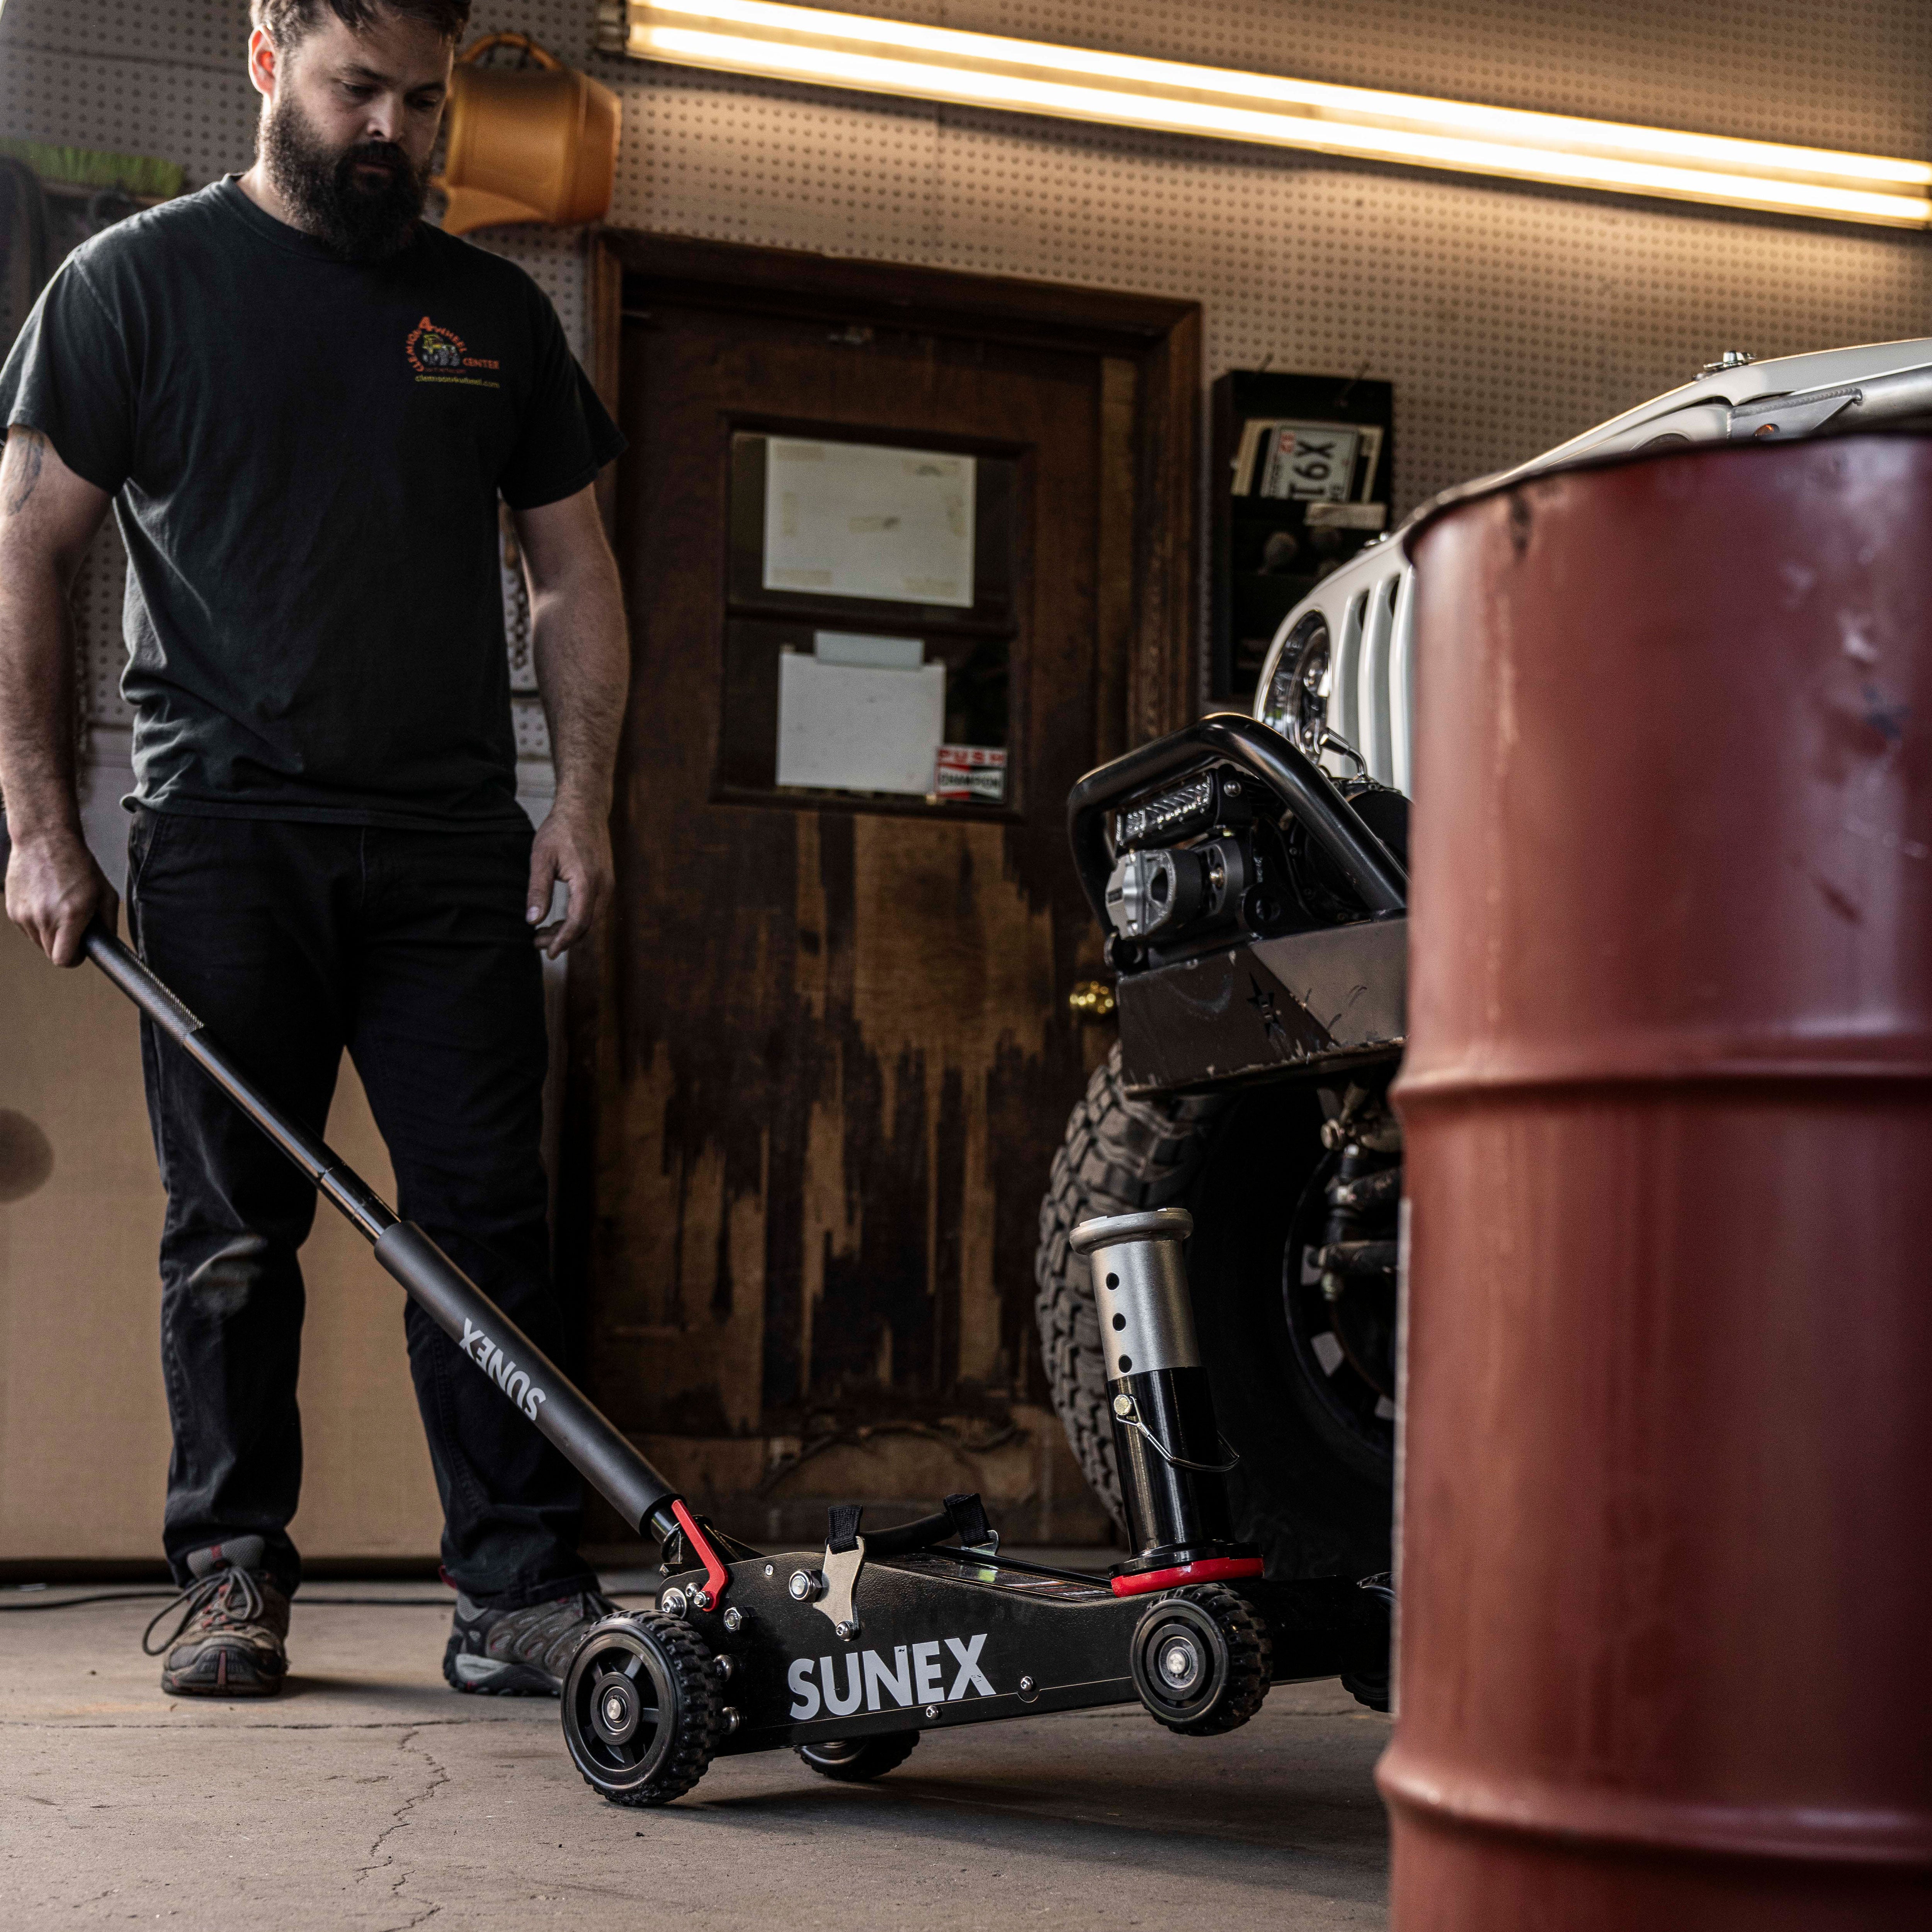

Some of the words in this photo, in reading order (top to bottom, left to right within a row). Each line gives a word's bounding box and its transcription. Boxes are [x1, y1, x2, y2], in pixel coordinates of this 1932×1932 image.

[463, 357, 500, 369] CENTER
[938, 749, 1005, 764] PUSH
[939, 774, 1004, 789] CHAMPION
[459, 1317, 546, 1421] SUNEX
[787, 1634, 997, 1720] SUNEX
